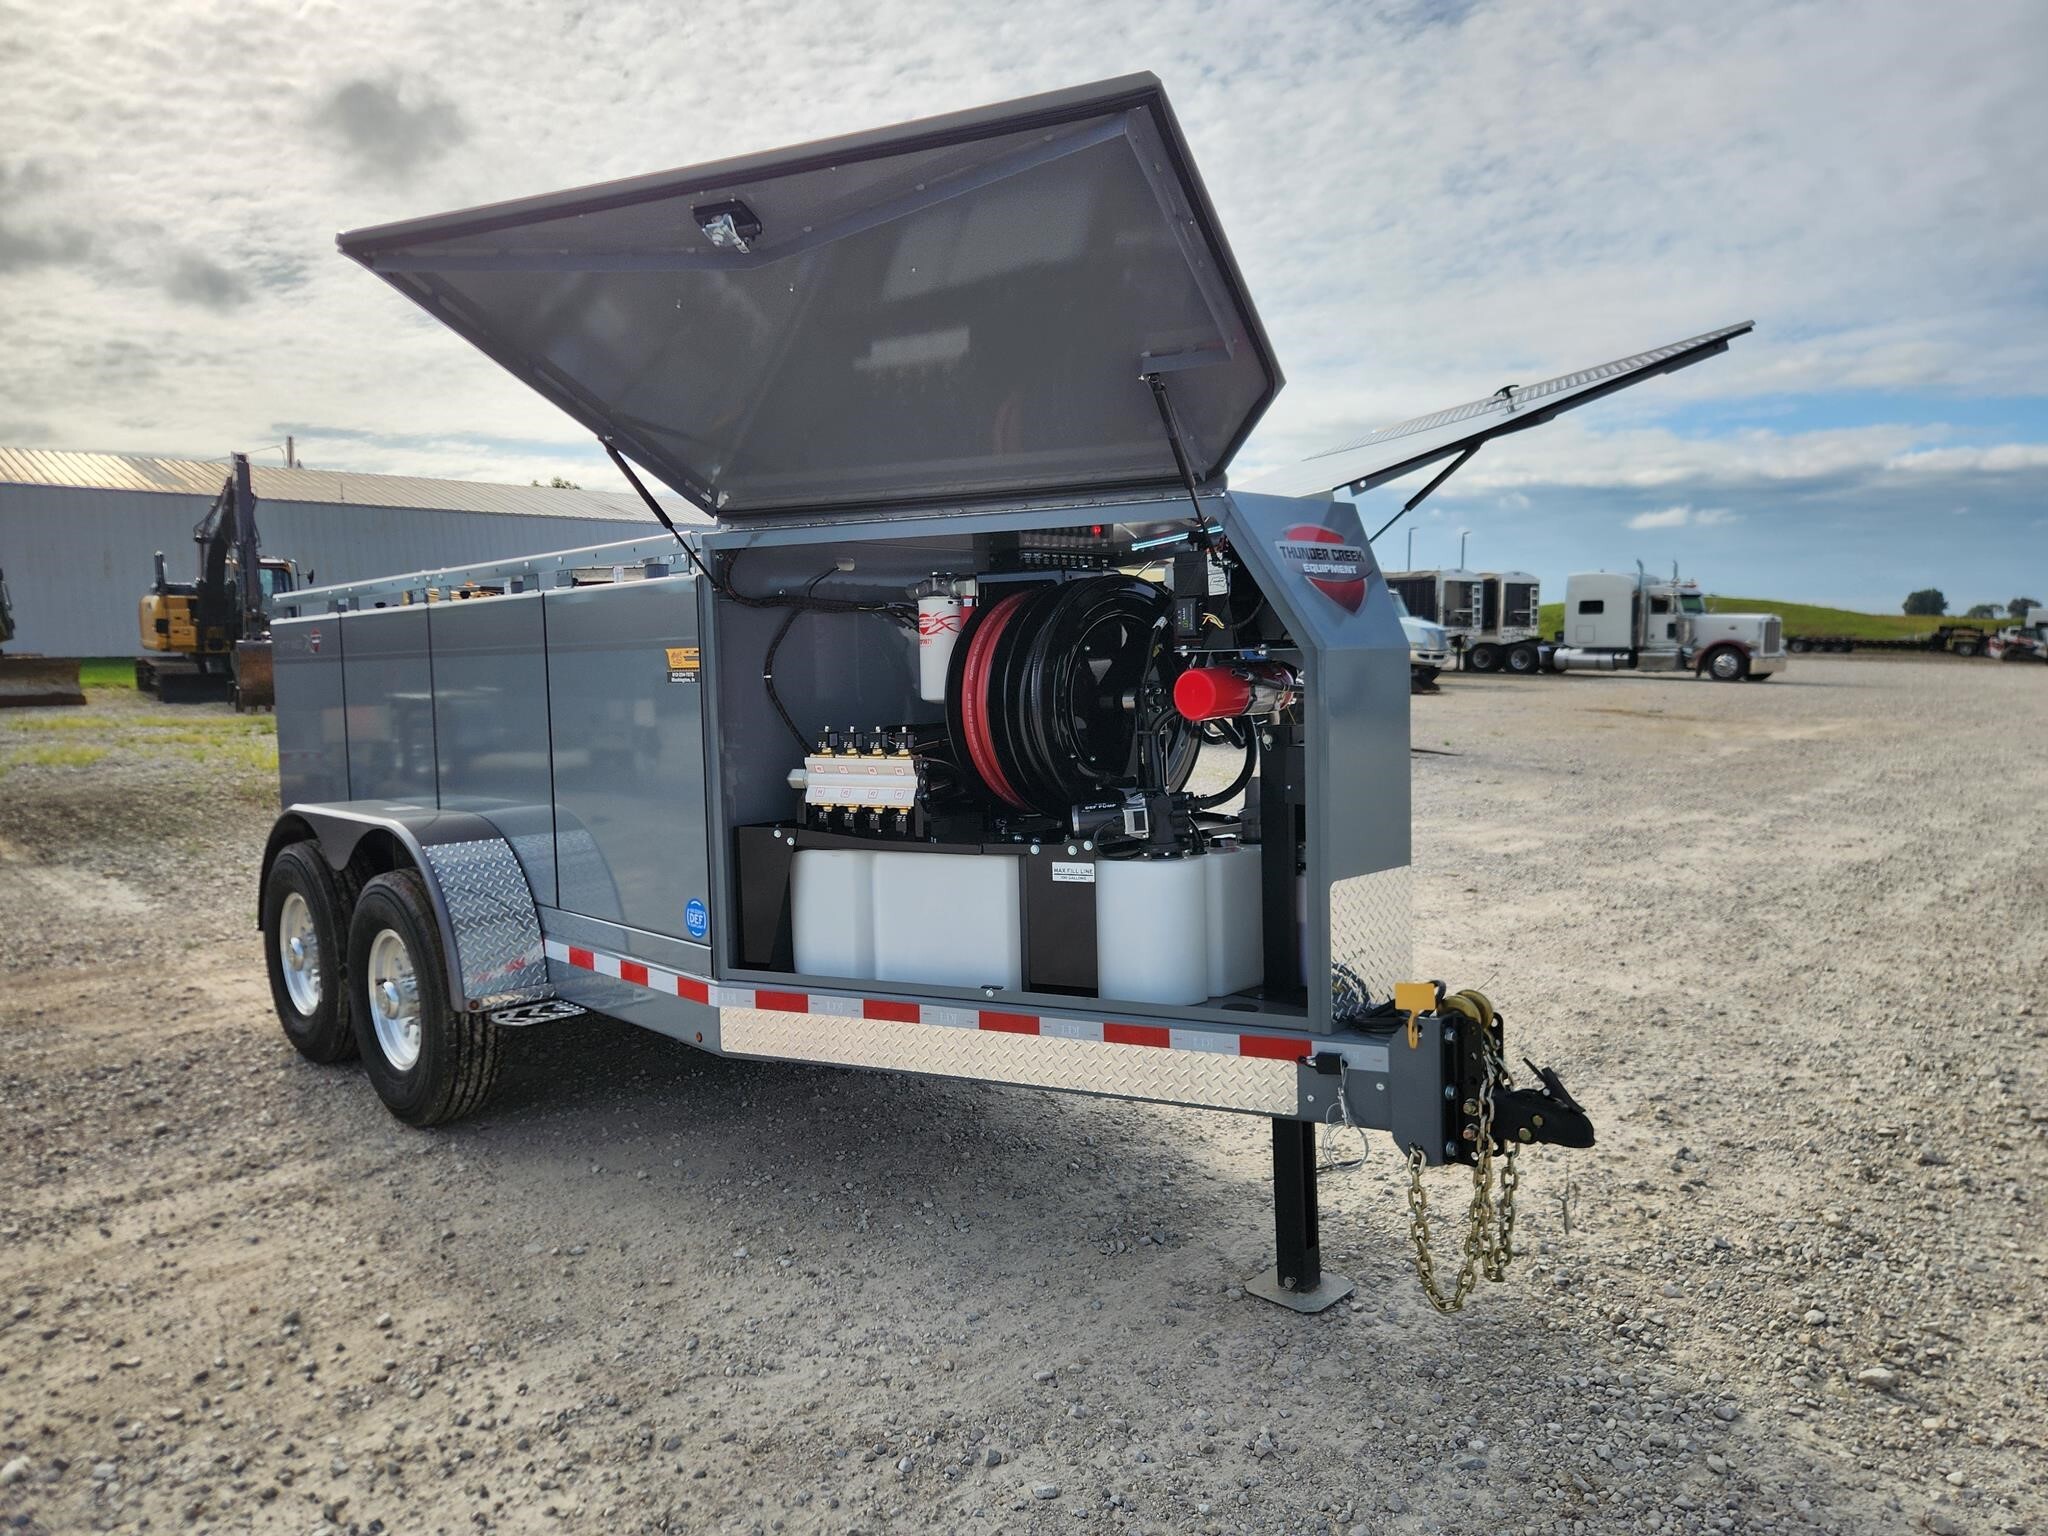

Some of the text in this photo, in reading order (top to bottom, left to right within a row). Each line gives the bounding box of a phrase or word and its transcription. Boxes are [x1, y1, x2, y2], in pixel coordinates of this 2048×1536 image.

[1279, 545, 1365, 563] THUNDER CREEK
[1302, 563, 1358, 575] EQUIPMENT
[689, 912, 704, 925] DEF
